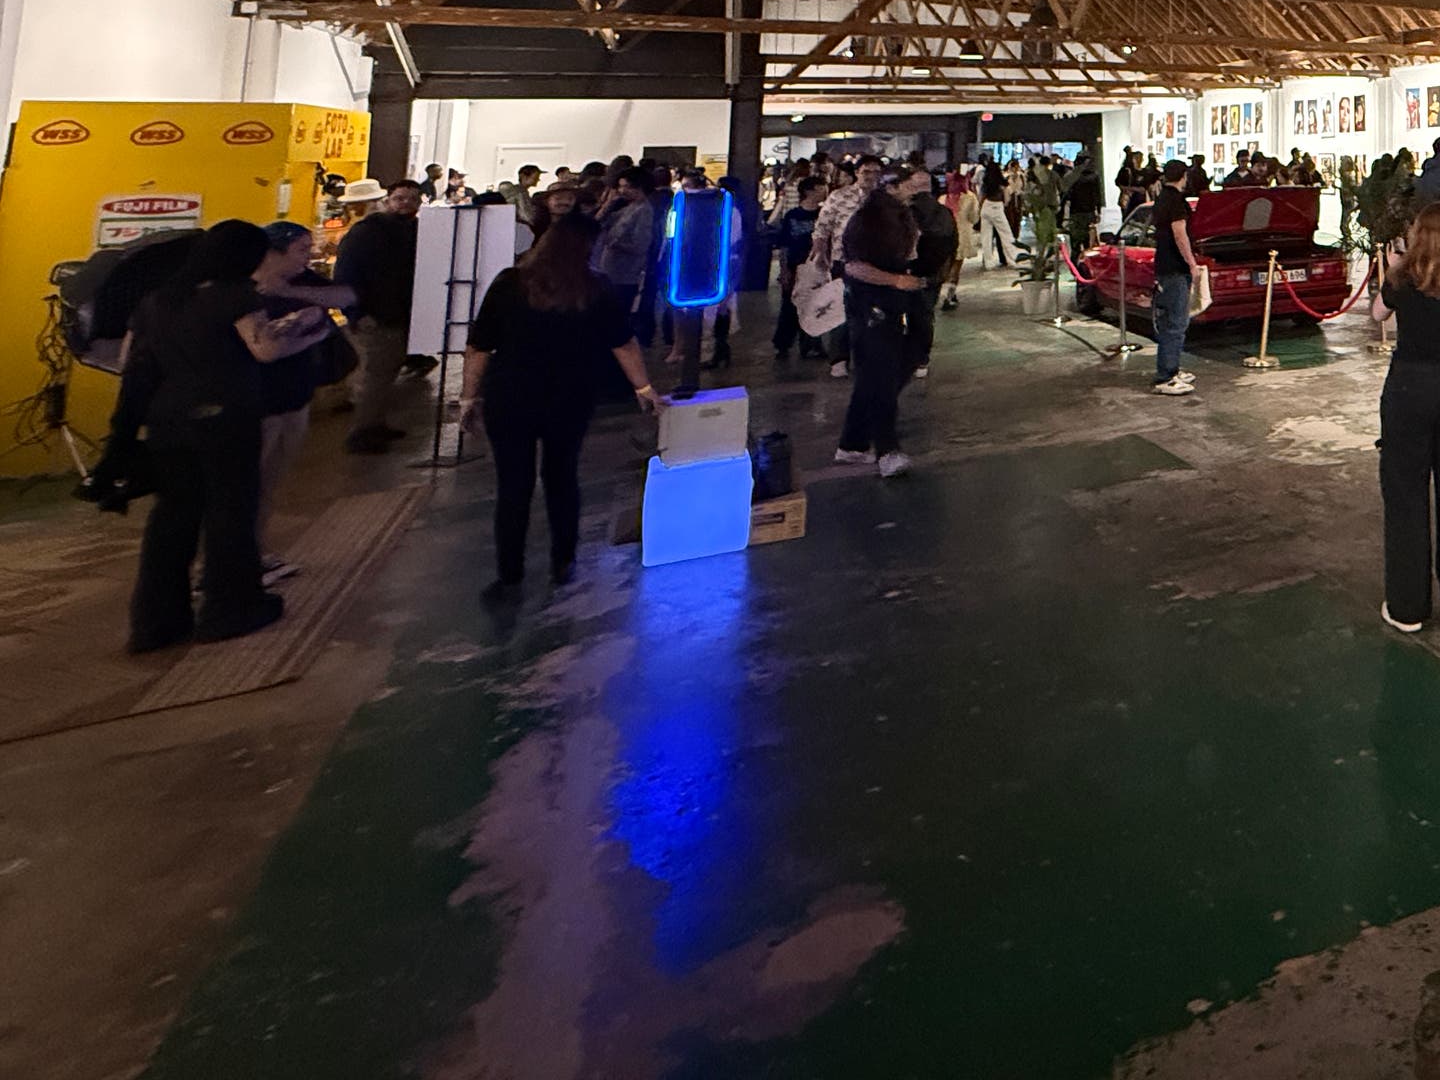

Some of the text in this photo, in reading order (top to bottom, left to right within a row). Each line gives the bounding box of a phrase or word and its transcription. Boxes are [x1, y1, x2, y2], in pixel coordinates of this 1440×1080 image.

[324, 112, 349, 134] FOTO
[41, 129, 83, 140] WSS
[139, 130, 178, 140] WSS
[231, 130, 267, 140] WSS
[324, 136, 344, 159] LAB
[112, 200, 189, 212] FUJI FILM
